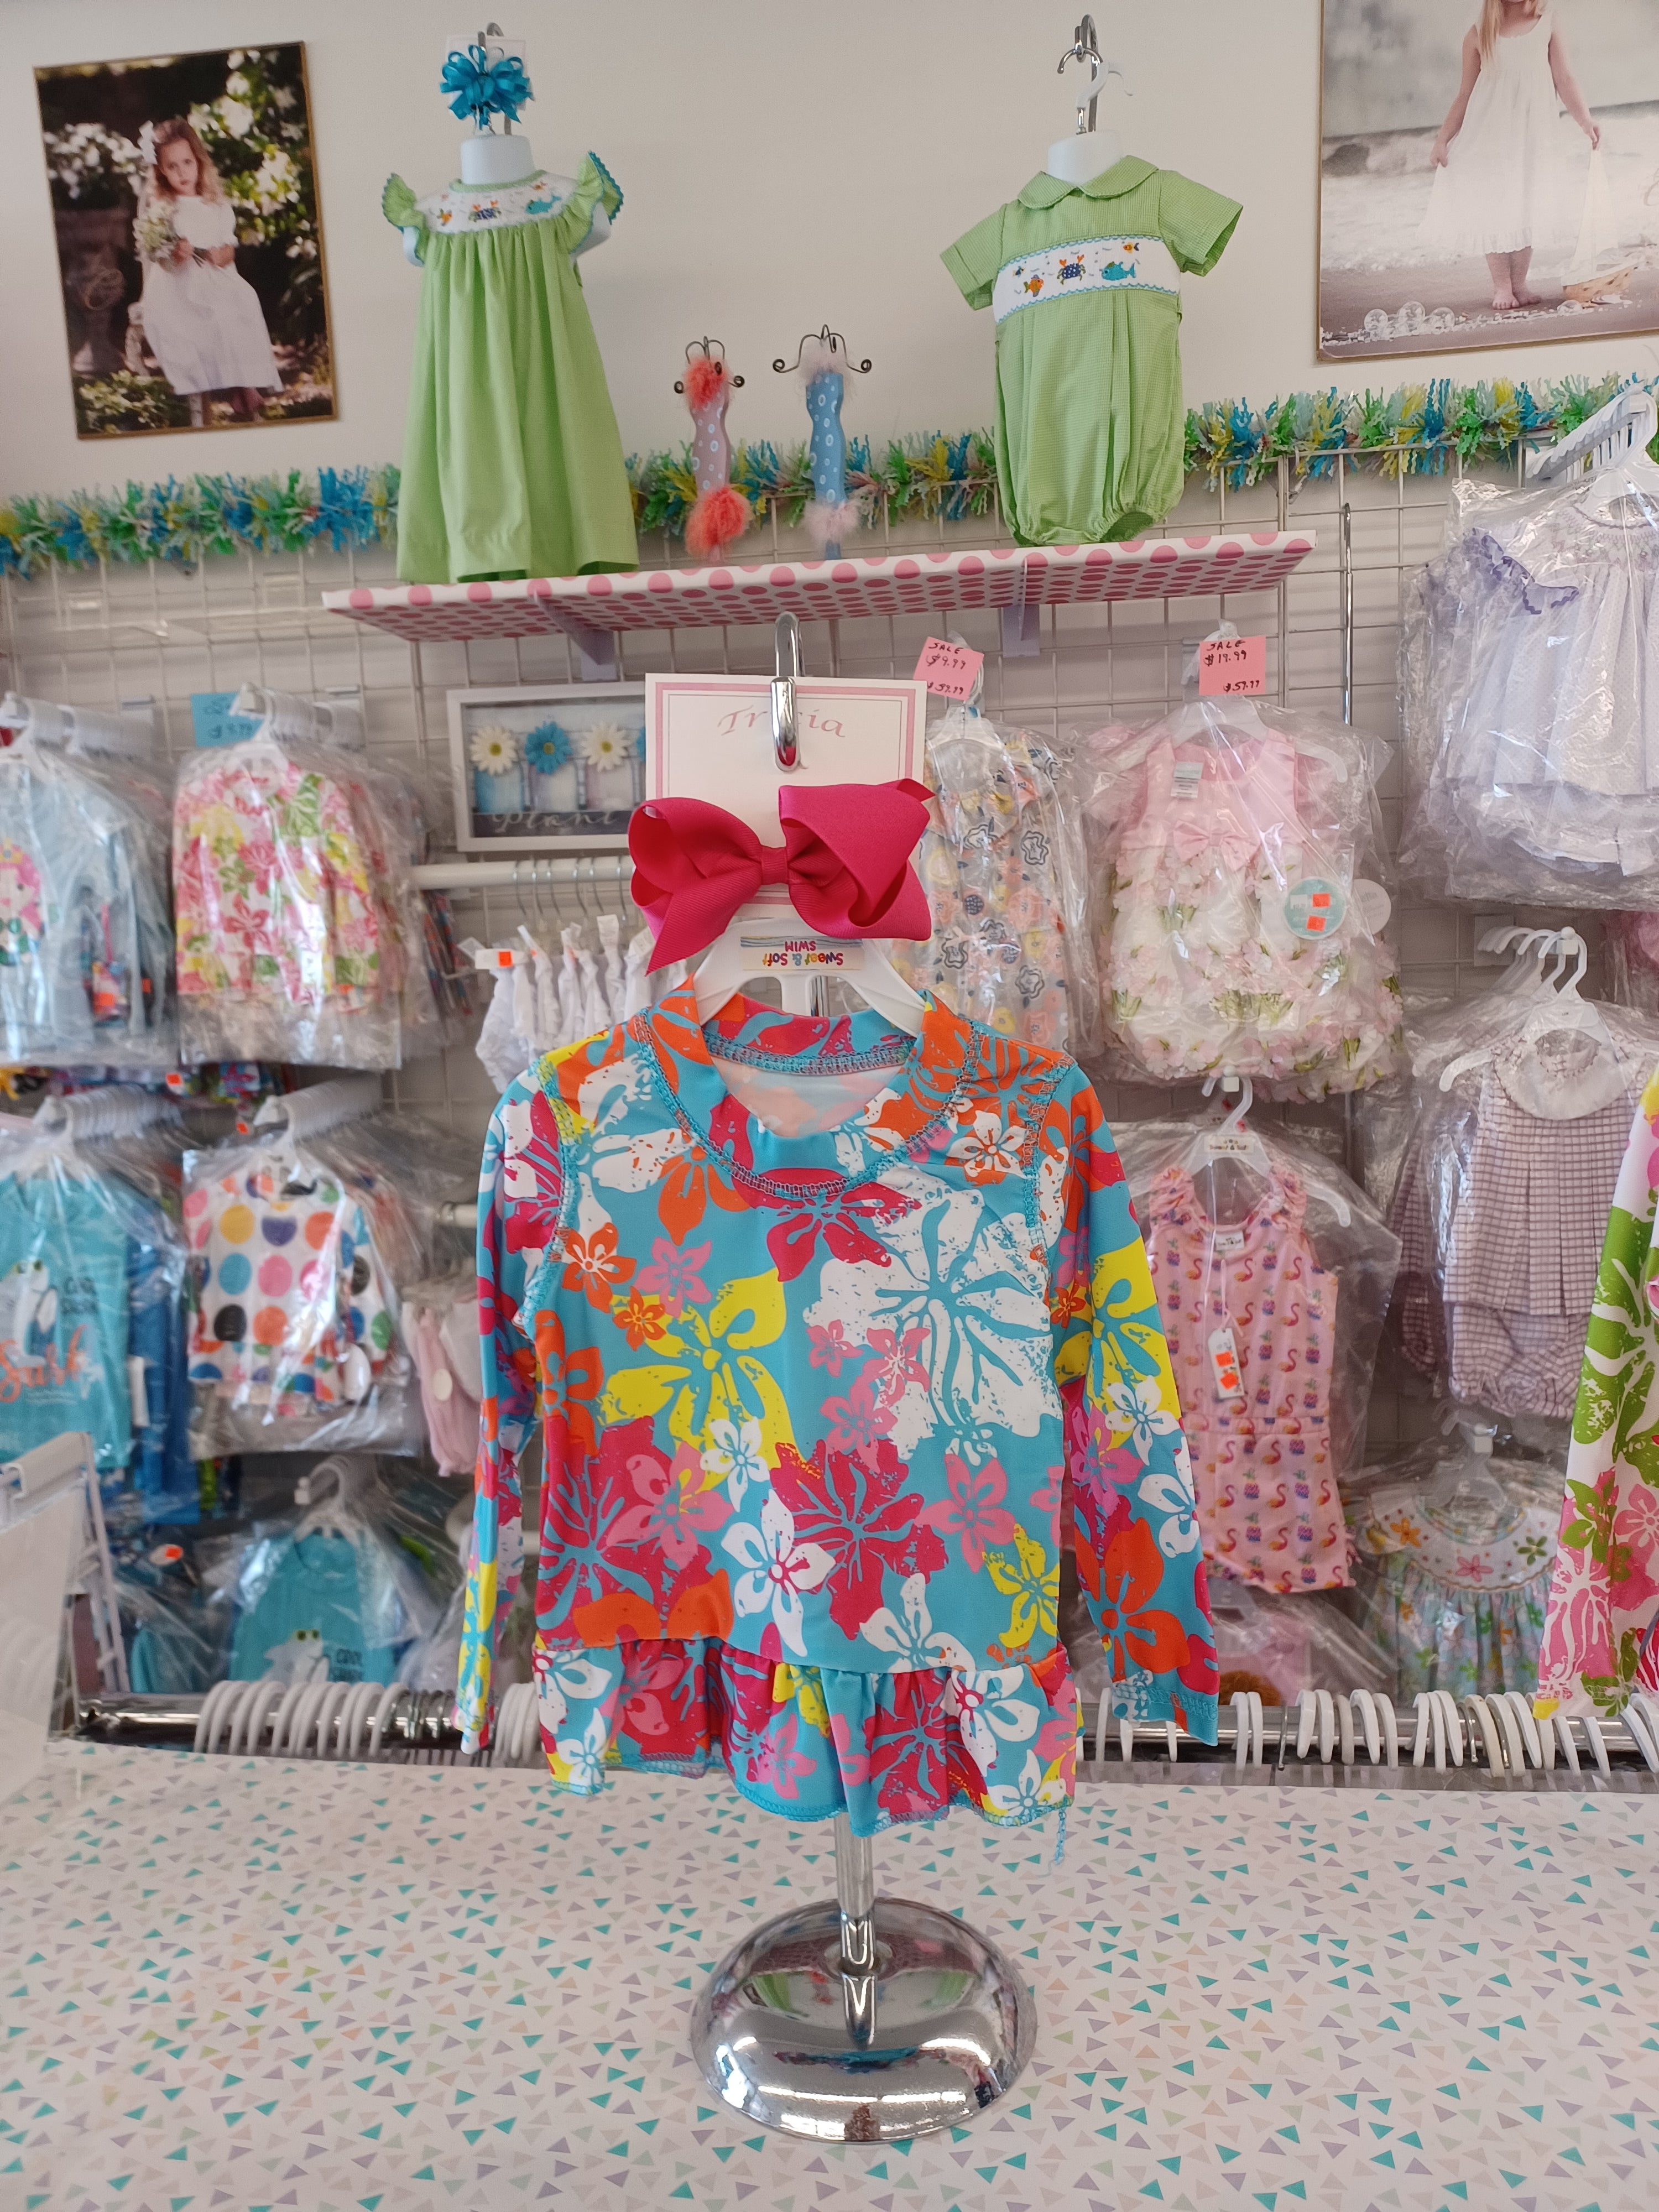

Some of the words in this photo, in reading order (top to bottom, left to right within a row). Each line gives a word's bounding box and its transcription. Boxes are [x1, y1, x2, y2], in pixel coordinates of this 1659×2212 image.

[928, 643, 964, 654] SALE
[1206, 640, 1246, 651] SALE
[926, 654, 966, 670] $9.99
[1203, 650, 1246, 667] $19.99
[717, 705, 846, 738] Tria
[784, 940, 816, 952] SWIM
[762, 953, 788, 967] Soft
[792, 953, 802, 966] &
[805, 952, 844, 966] Sweet
